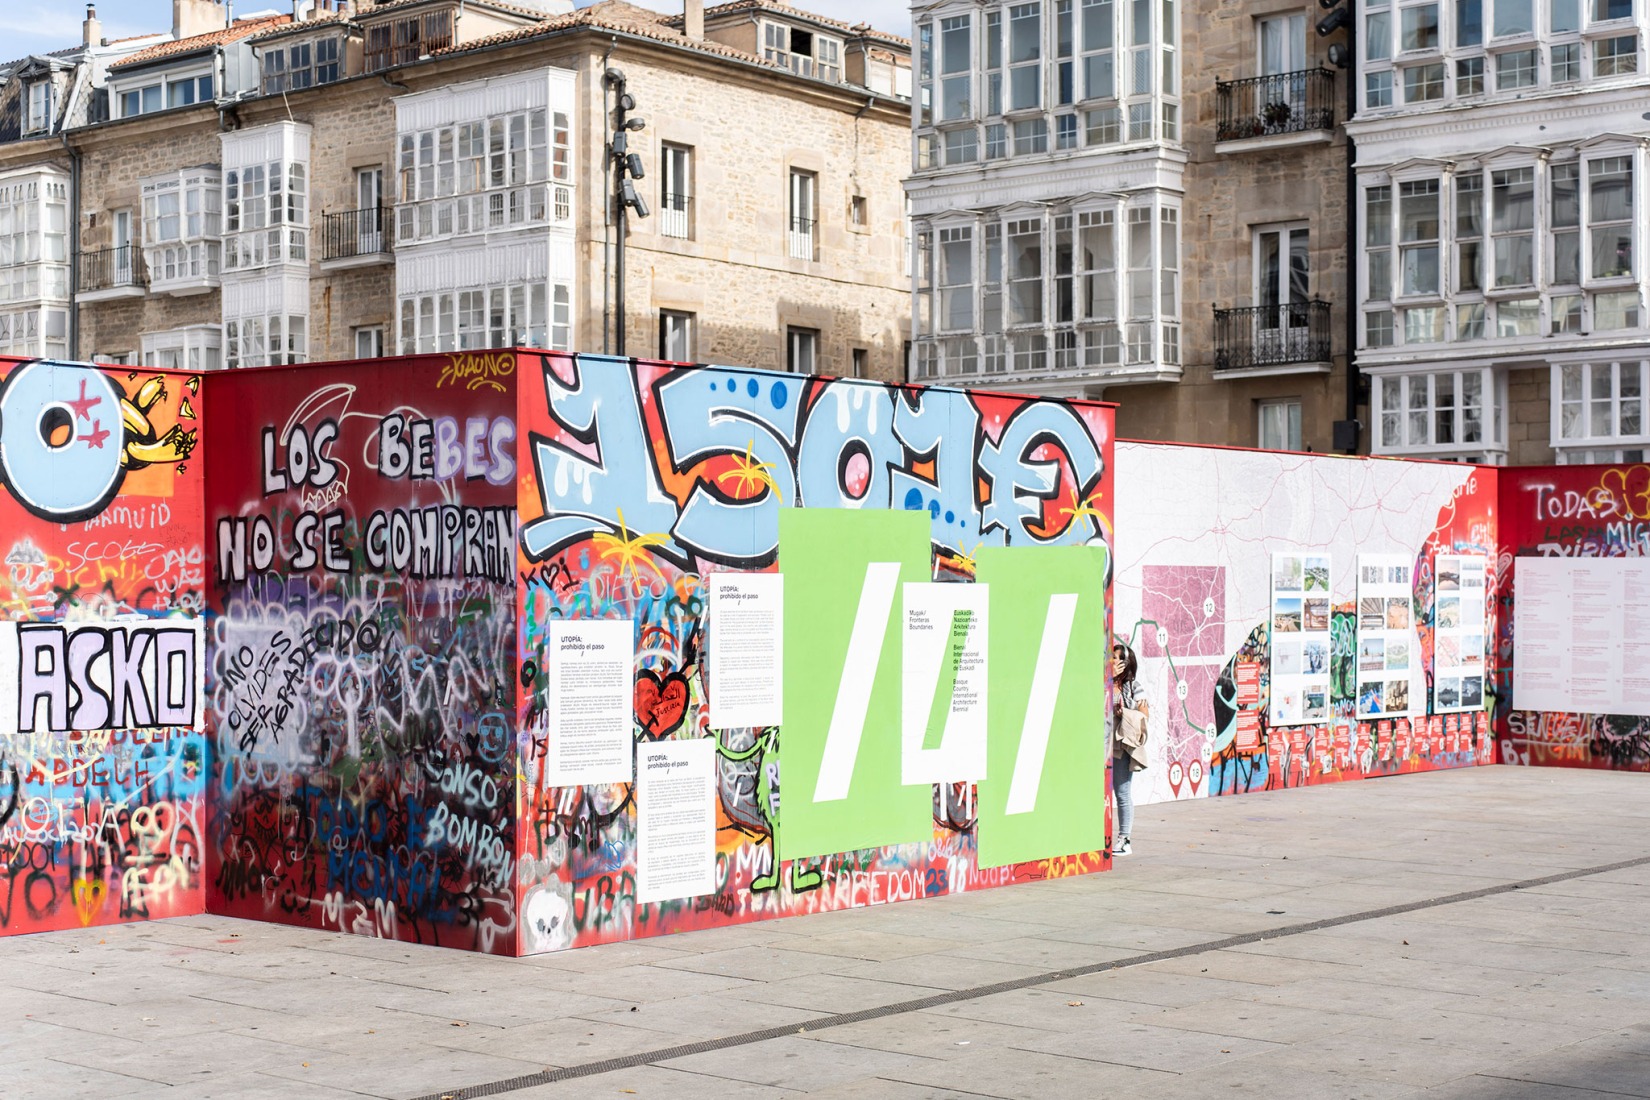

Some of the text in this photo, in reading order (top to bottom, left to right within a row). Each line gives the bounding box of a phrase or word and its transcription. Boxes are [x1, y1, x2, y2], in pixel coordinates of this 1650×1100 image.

[262, 413, 517, 497] LOS BEBES
[217, 505, 517, 588] NO SE COMPRAN
[1205, 603, 1213, 612] 12
[16, 621, 197, 733] ASKO
[648, 761, 671, 769] prohibido
